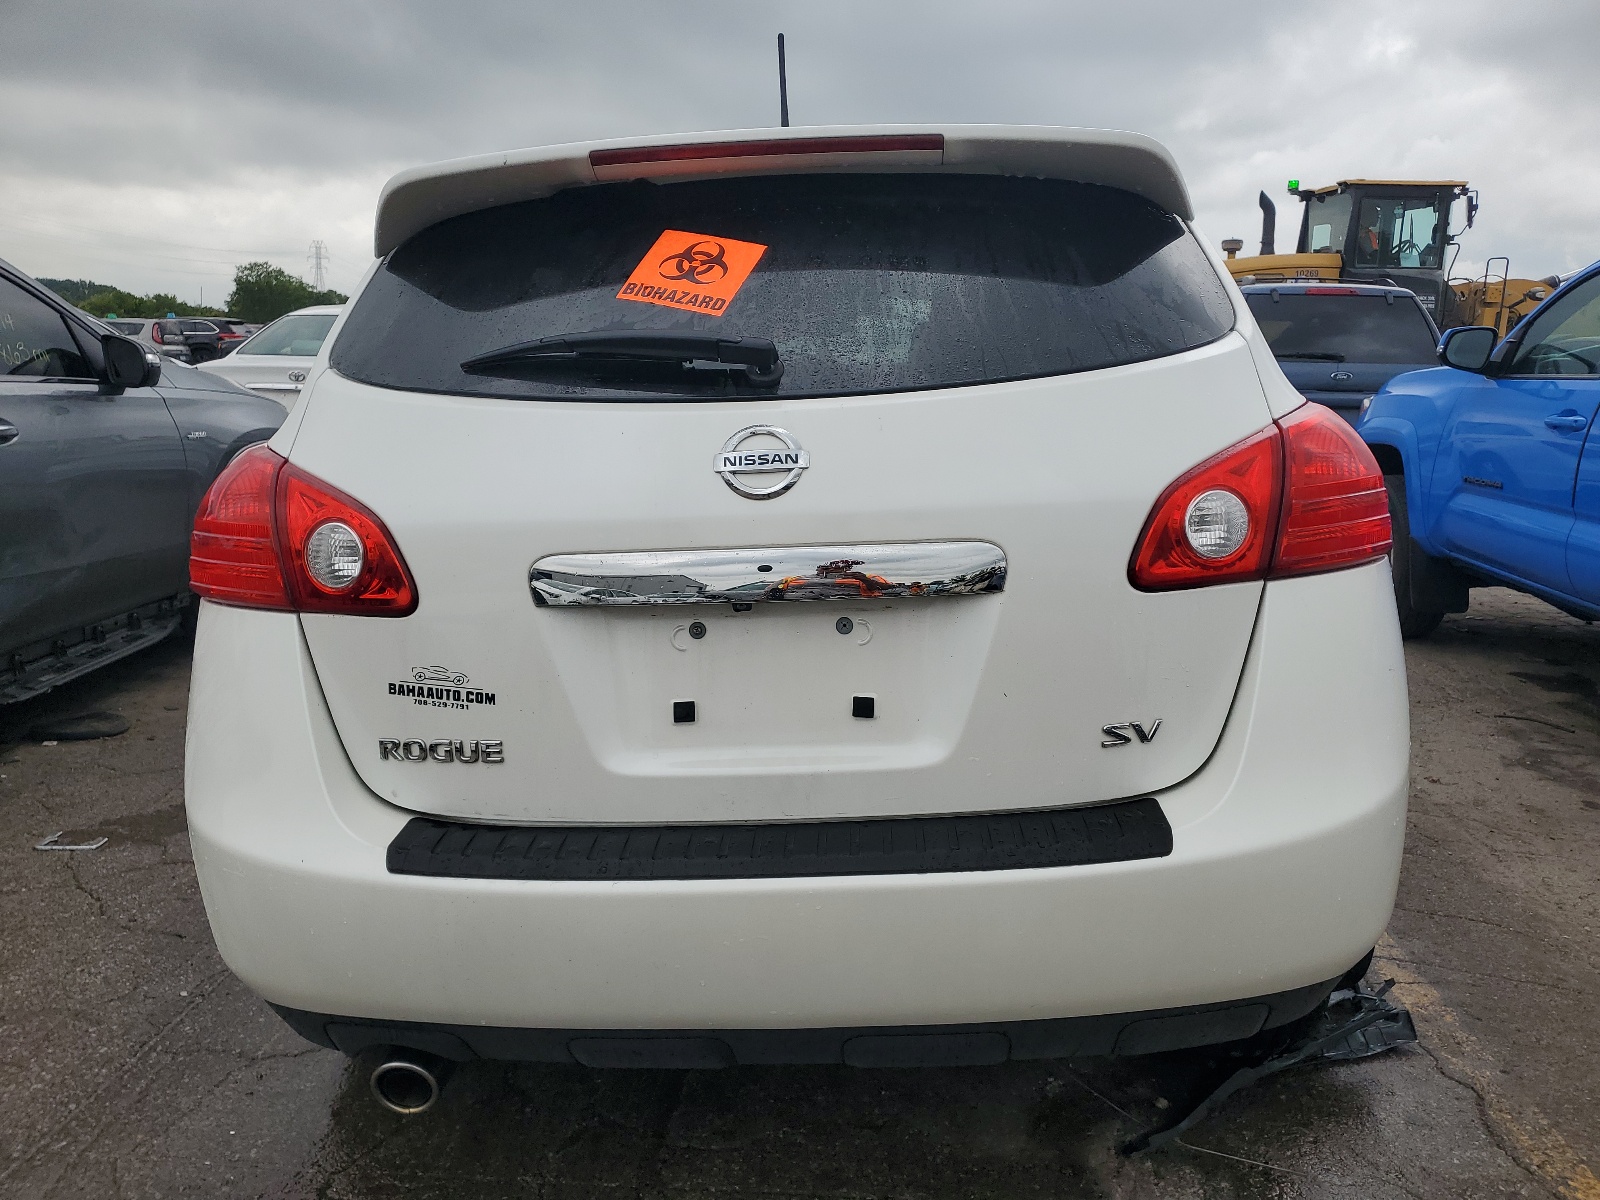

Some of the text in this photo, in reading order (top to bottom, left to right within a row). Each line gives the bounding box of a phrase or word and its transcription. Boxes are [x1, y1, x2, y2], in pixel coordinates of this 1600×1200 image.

[621, 282, 727, 311] BIOHAZARD
[723, 453, 799, 467] NISSAN
[388, 682, 496, 705] BAHAAUTO.COM
[413, 699, 470, 710] 708-529-7791
[1101, 719, 1162, 748] SV
[378, 738, 504, 764] ROGUE
